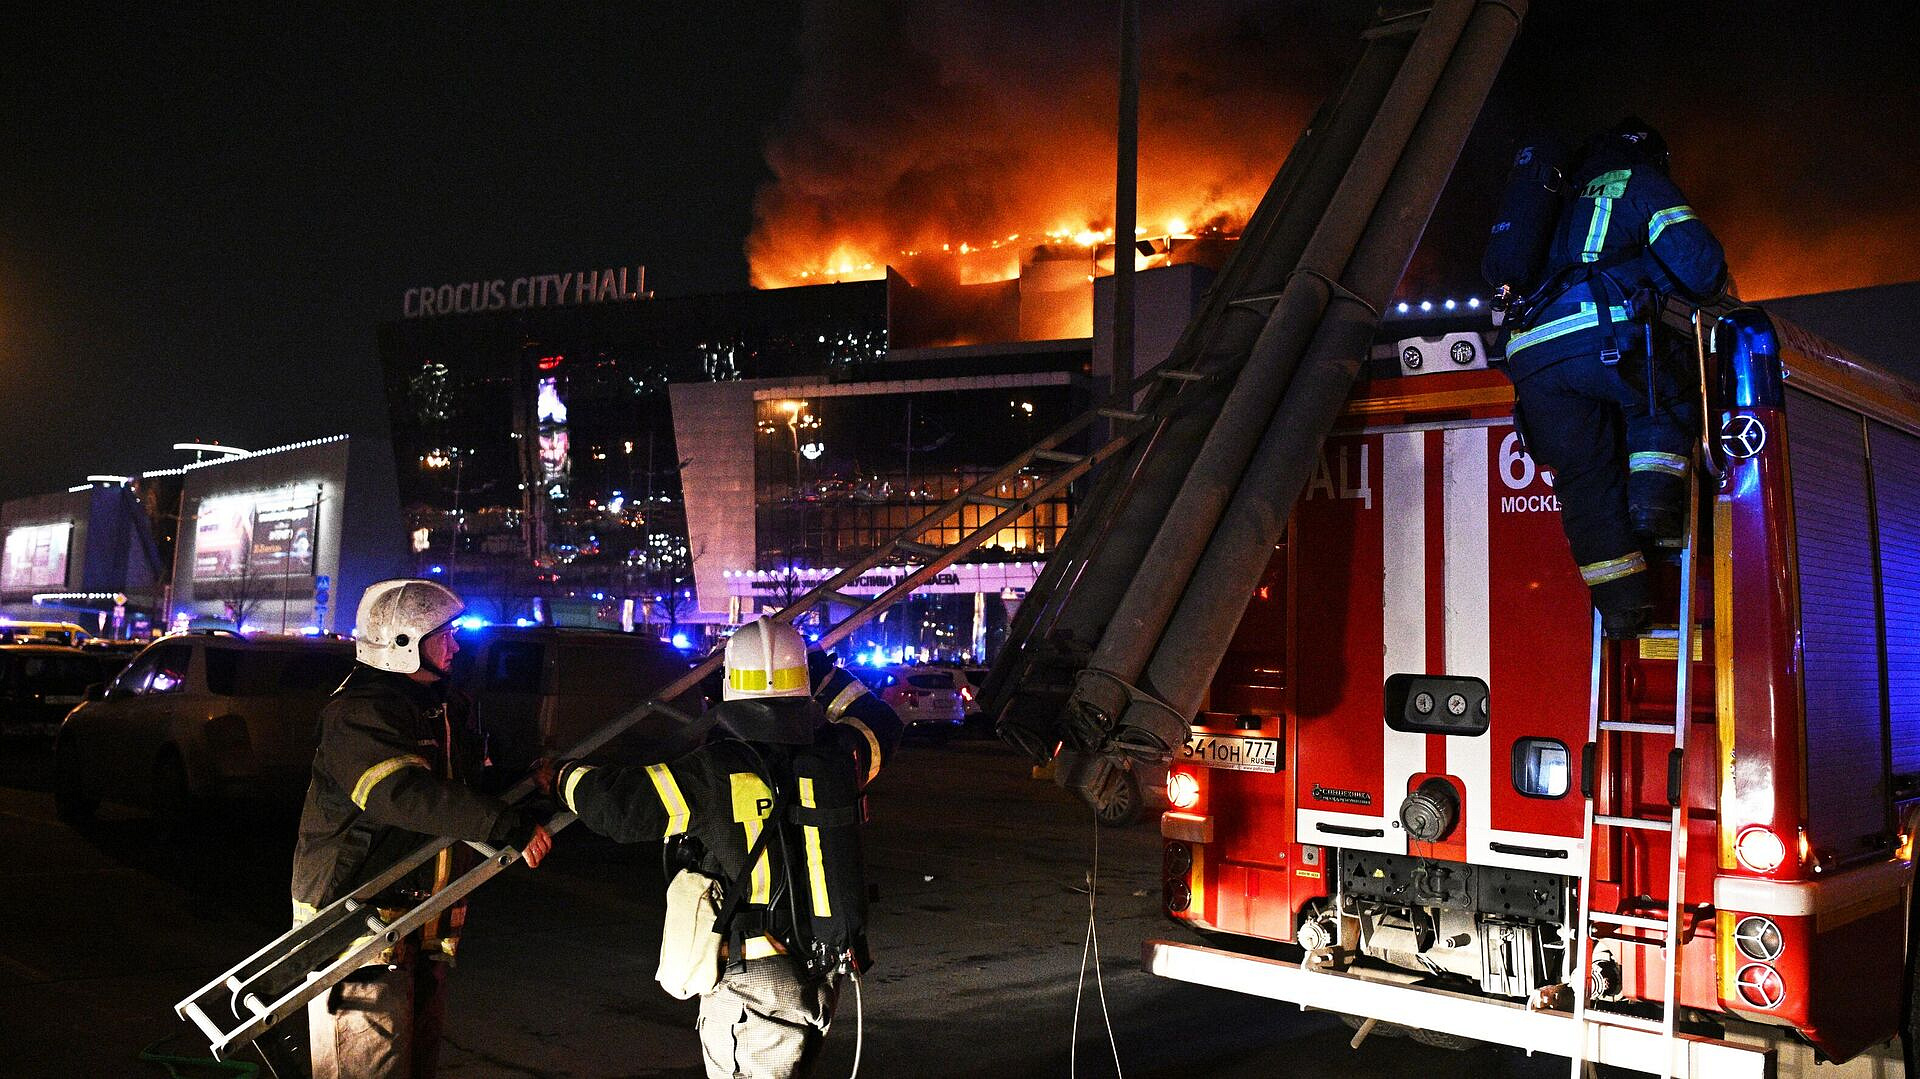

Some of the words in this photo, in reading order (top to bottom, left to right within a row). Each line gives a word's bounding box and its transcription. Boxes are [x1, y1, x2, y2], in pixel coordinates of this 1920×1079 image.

[403, 279, 505, 318] CROCUS
[511, 273, 572, 309] CITY
[576, 265, 654, 304] HALL
[1498, 431, 1556, 490] 6
[1245, 741, 1272, 758] 777
